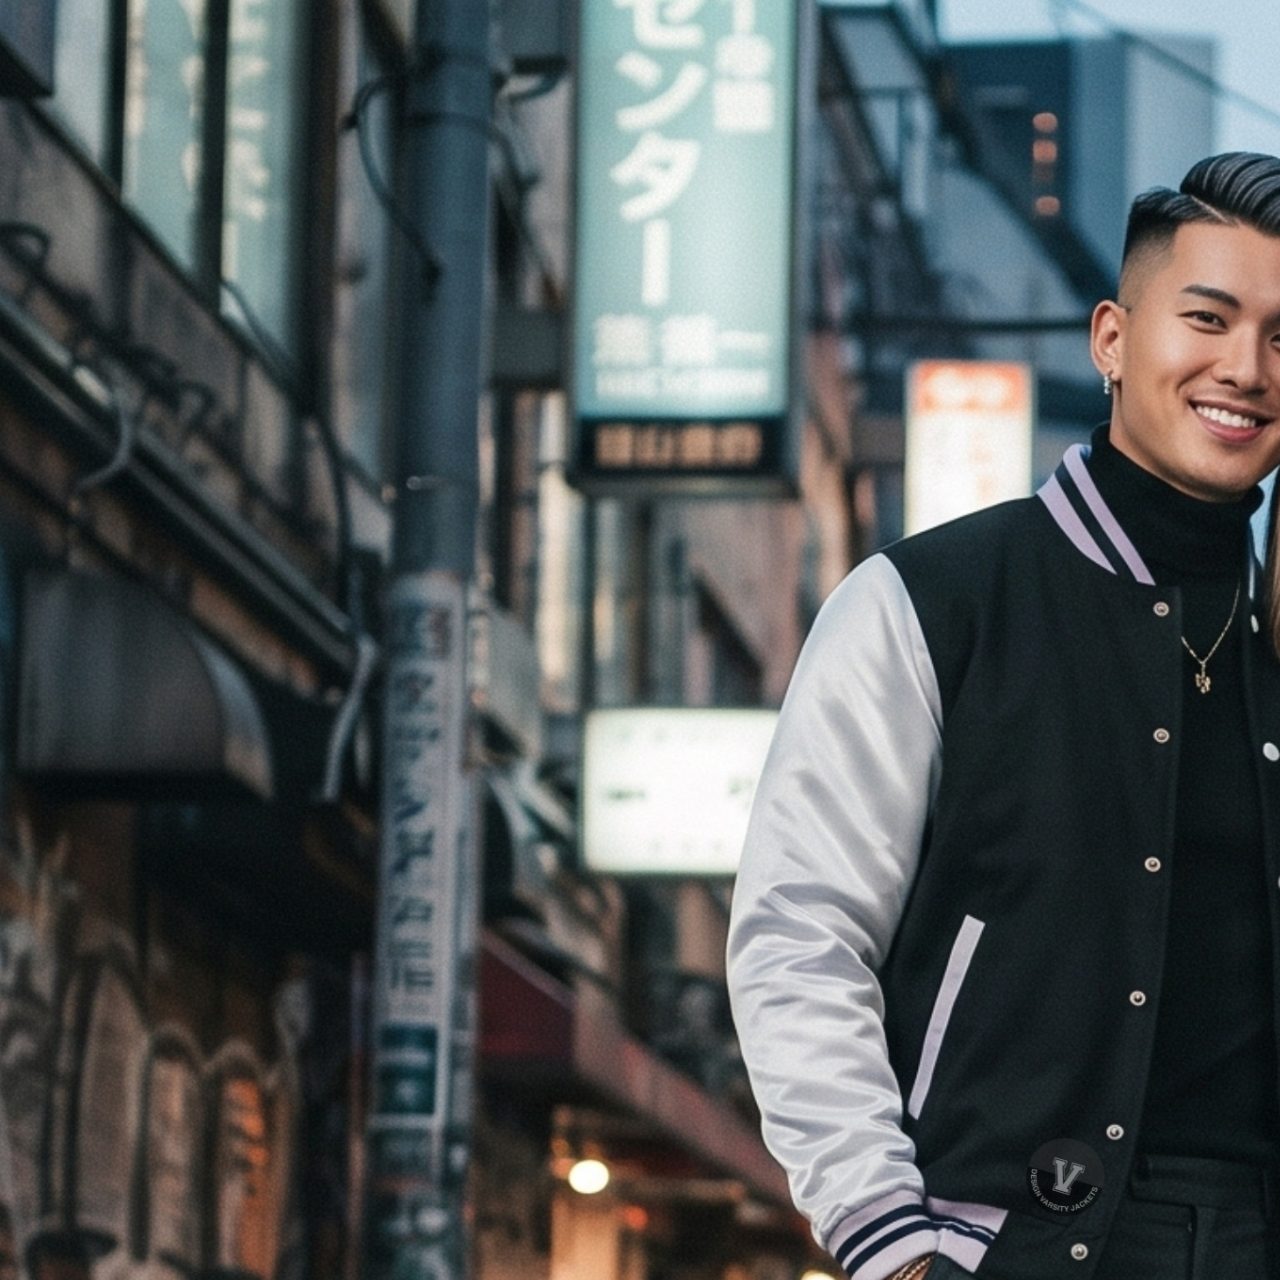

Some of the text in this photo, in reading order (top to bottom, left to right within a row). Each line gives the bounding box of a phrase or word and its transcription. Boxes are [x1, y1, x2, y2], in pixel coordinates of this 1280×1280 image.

[1030, 1168, 1099, 1213] DESIGN VARSITY JACKETS
[1052, 1156, 1086, 1196] V
